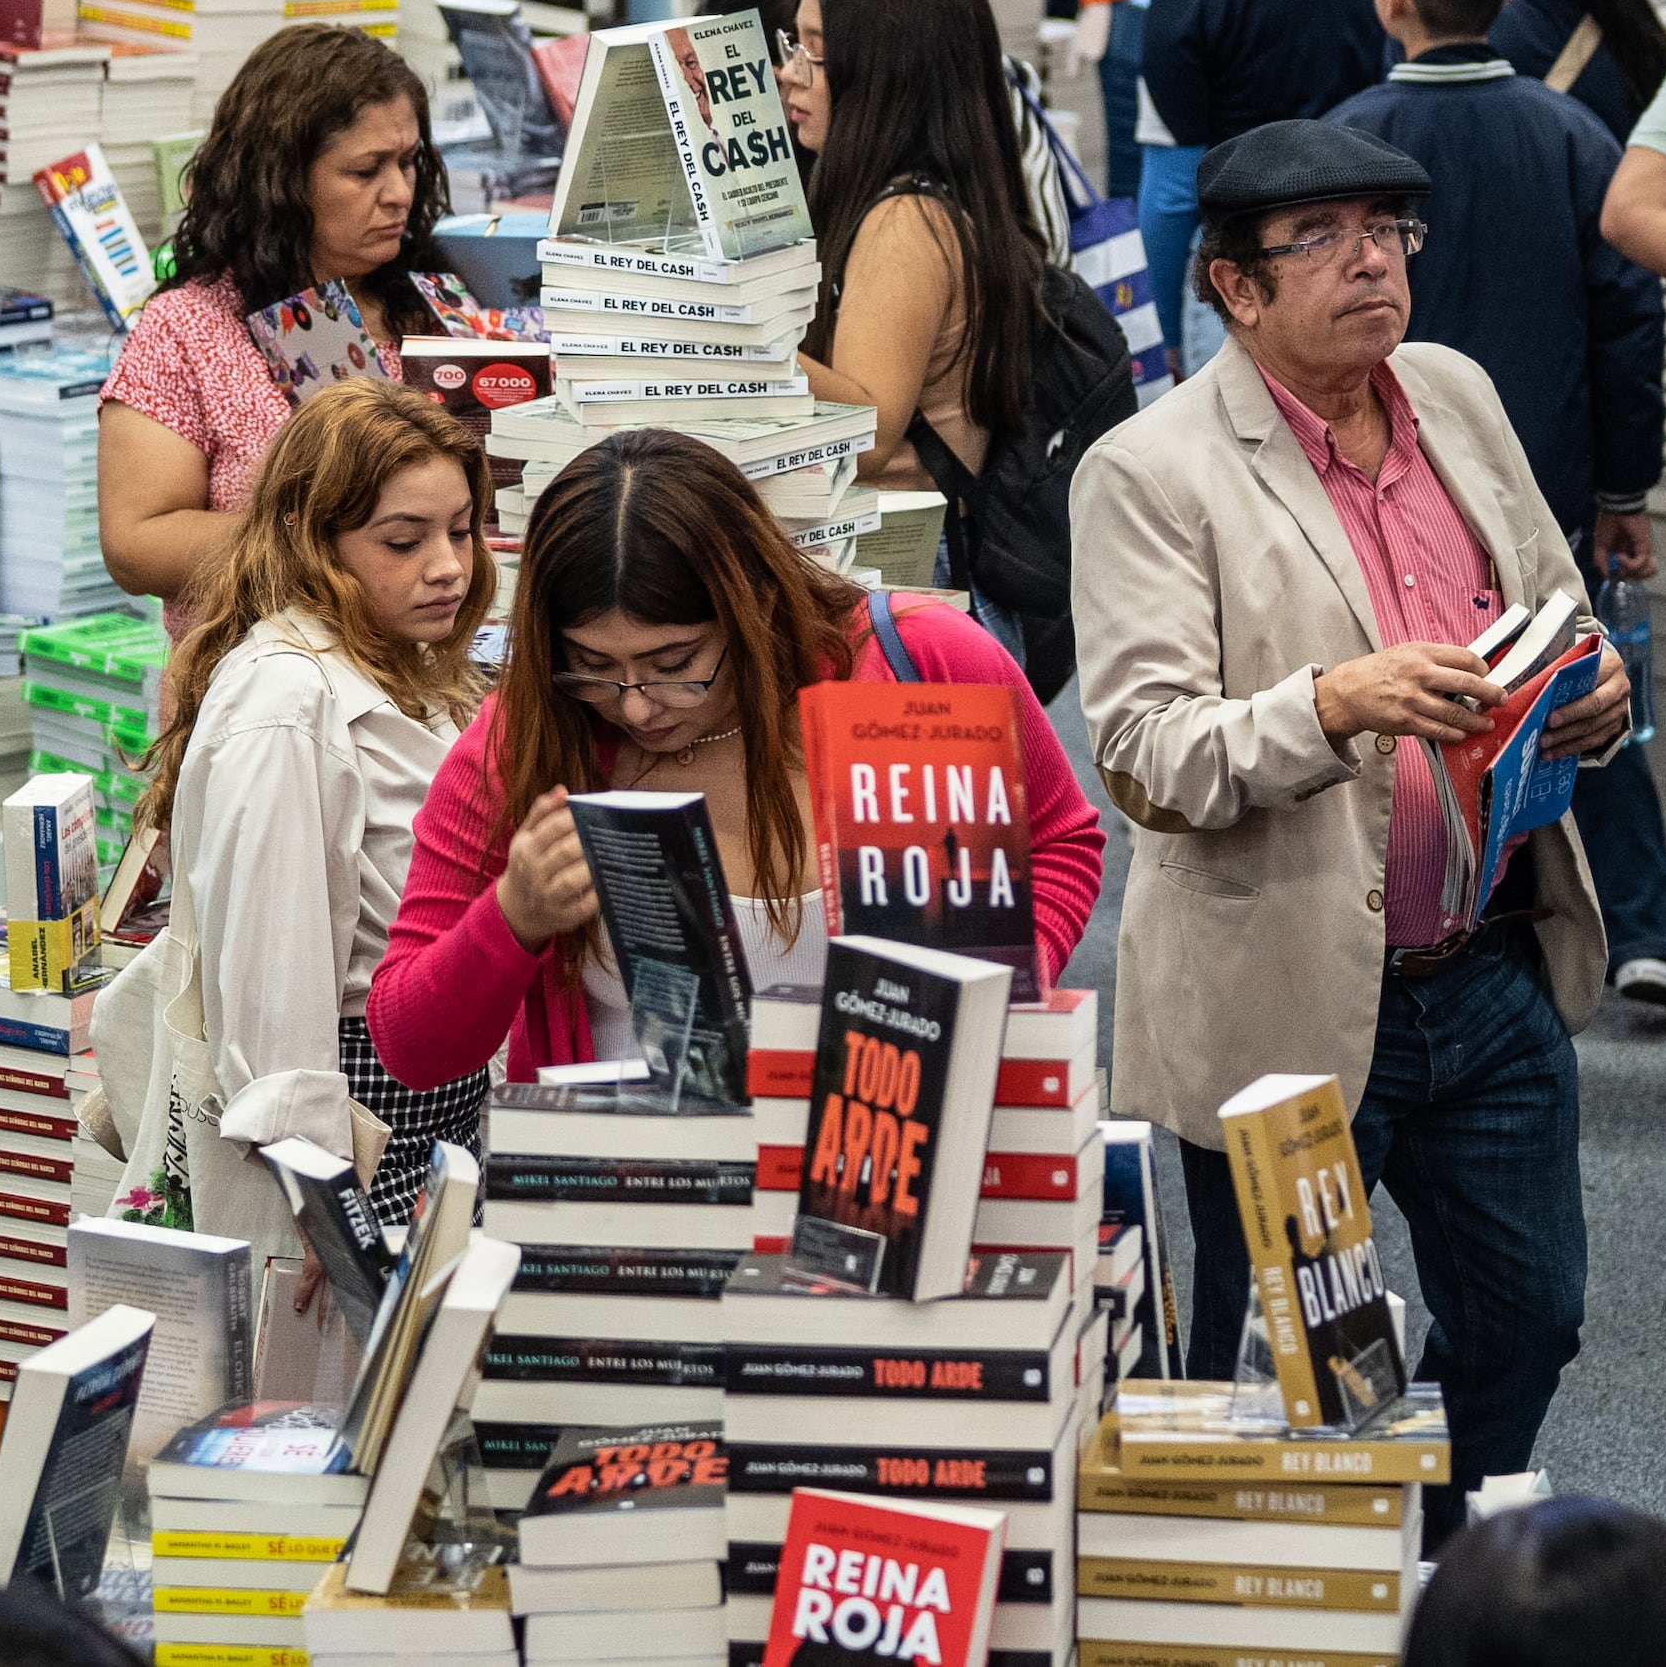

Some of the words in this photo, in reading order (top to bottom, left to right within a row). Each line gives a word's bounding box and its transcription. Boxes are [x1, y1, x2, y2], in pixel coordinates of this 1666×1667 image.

[694, 27, 723, 40] ELENA
[724, 44, 741, 59] EL
[705, 58, 766, 105] REY
[669, 101, 680, 119] EL
[732, 111, 756, 128] DEL
[674, 122, 690, 149] REY
[683, 152, 699, 181] DEL
[594, 254, 607, 266] EL
[610, 256, 633, 269] REY
[637, 259, 658, 272] DEL
[604, 298, 618, 309] EL
[622, 300, 647, 312] REY
[651, 302, 674, 314] DEL
[621, 341, 636, 352] EL
[641, 343, 669, 354] REY
[673, 344, 698, 355] DEL
[435, 371, 464, 380] 700
[645, 386, 661, 396] EL
[665, 385, 693, 396] REY
[697, 384, 723, 394] DEL
[777, 457, 788, 470] EL
[789, 452, 806, 467] REY
[808, 448, 825, 463] DEL
[809, 529, 826, 542] DEL
[903, 701, 951, 717] JUAN
[850, 762, 1012, 825] REINA
[858, 844, 1015, 909] ROJA
[873, 978, 910, 1003] JUAN
[843, 1030, 921, 1117] TODO
[810, 1092, 929, 1216] ARDE
[512, 1175, 549, 1185] MIKEL
[554, 1175, 618, 1186] SANTIAGO
[625, 1176, 665, 1188] ENTRE
[668, 1177, 692, 1188] LOS
[1295, 1160, 1354, 1238] REY
[1297, 1237, 1384, 1329] BLANCO
[517, 1354, 580, 1366] SANTIAGO
[588, 1357, 626, 1369] ENTRE
[632, 1358, 654, 1370] LOS
[742, 1362, 772, 1376] JUAN
[873, 1359, 926, 1387] TODO
[932, 1361, 983, 1389] ARDE
[594, 1439, 718, 1465] TODO
[1282, 1451, 1311, 1472] REY
[1315, 1452, 1372, 1473] BLANCO
[546, 1456, 730, 1498] ARDE
[746, 1461, 776, 1475] JUAN
[876, 1457, 930, 1486] TODO
[934, 1459, 986, 1488] ARDE
[802, 1543, 951, 1614] REINA
[1235, 1575, 1262, 1596] REY
[1267, 1577, 1324, 1599] BLANCO
[792, 1586, 942, 1666] ROJA
